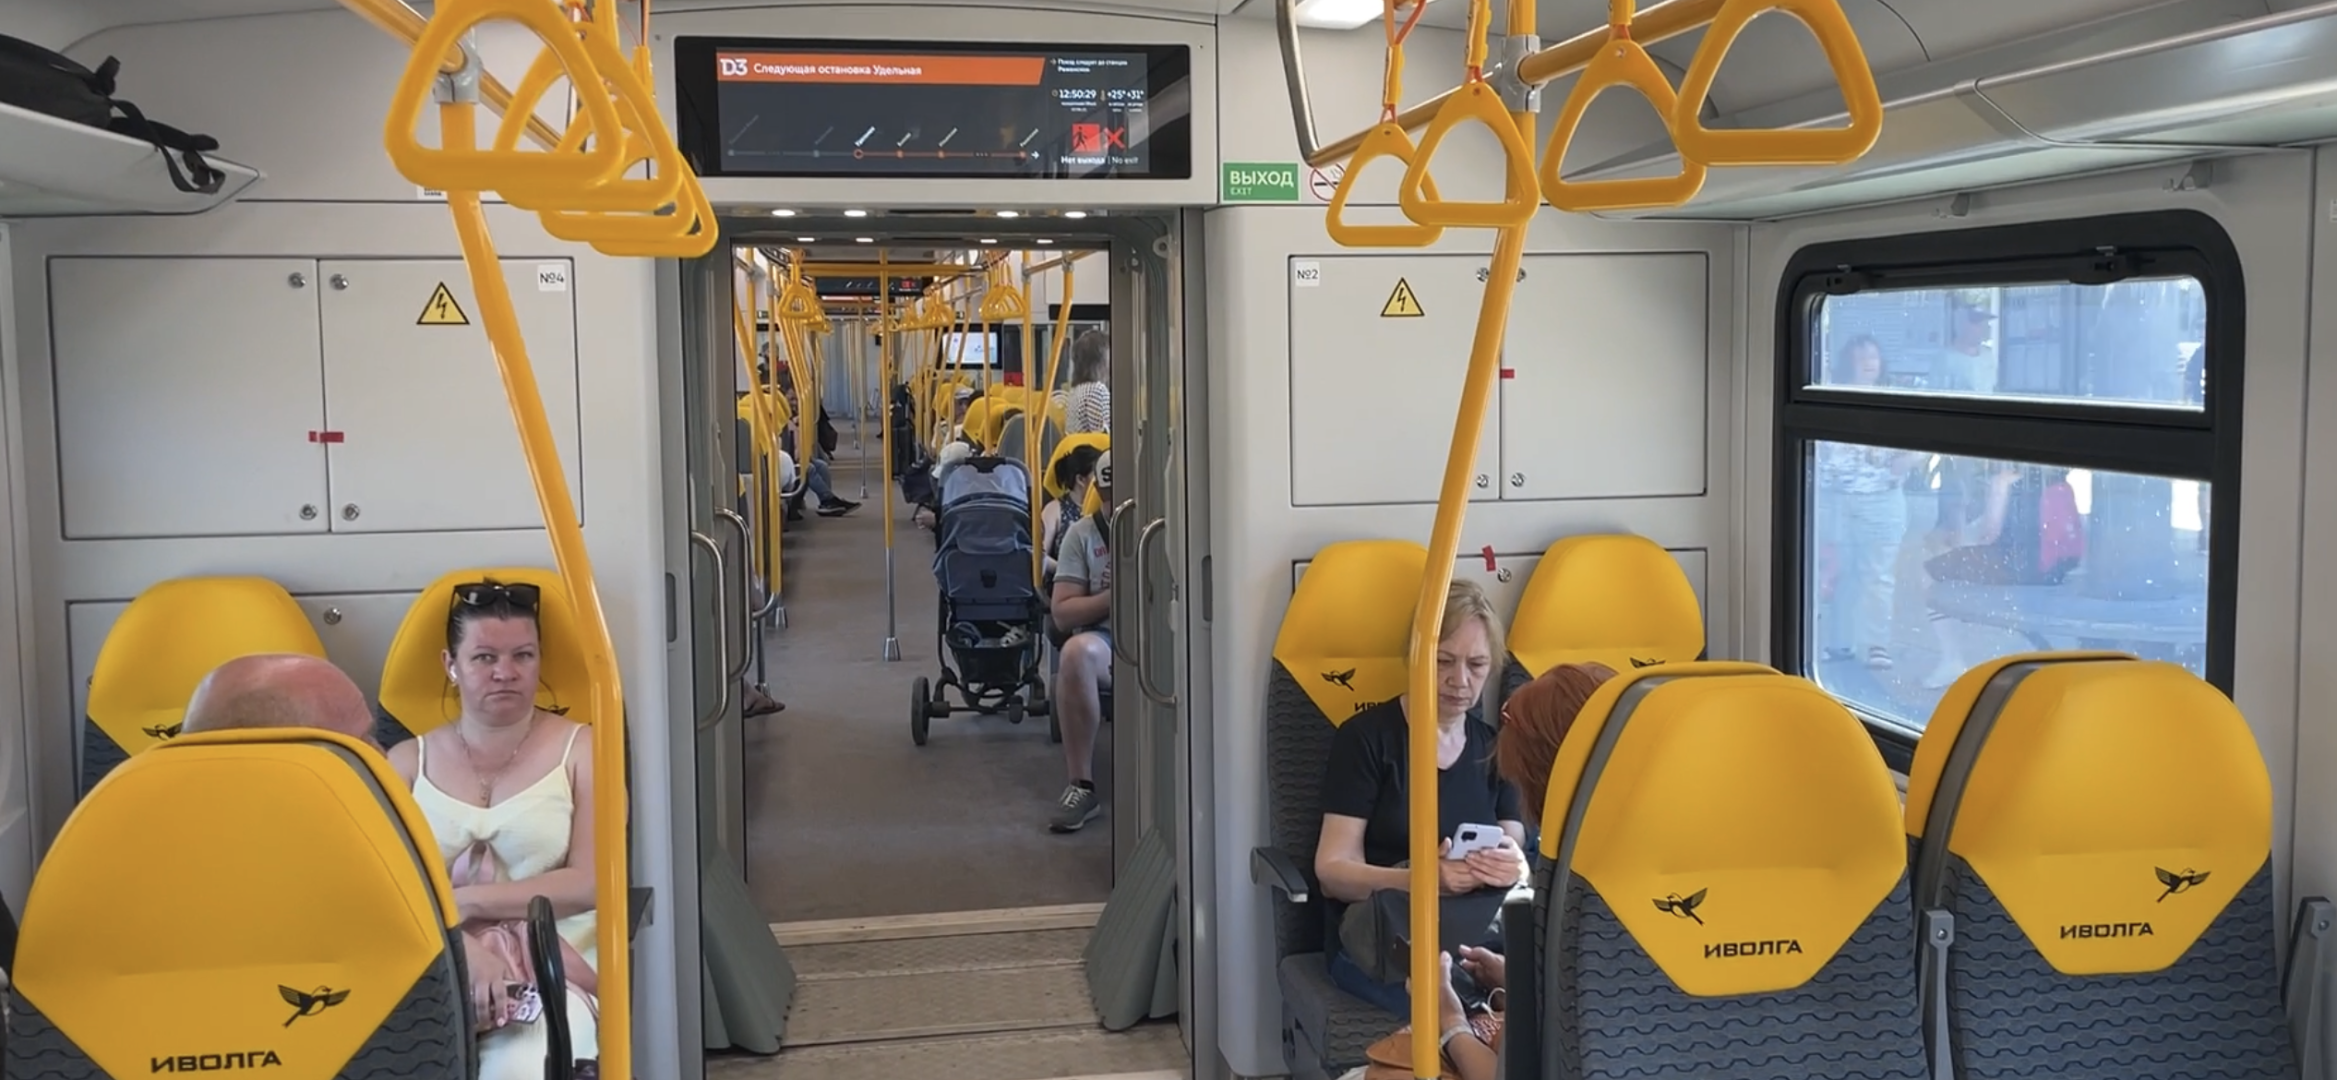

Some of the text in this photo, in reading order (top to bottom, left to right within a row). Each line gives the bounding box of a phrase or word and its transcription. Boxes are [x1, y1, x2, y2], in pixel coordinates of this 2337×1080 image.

[719, 58, 922, 76] D3 Следующая остановка Удельная
[1059, 88, 1097, 99] 12:50:29
[1061, 156, 1076, 164] Нет
[1230, 170, 1294, 188] ВЫХОД
[1230, 187, 1252, 195] EXIT
[540, 272, 564, 284] №4
[1297, 268, 1319, 280] №2
[2060, 922, 2154, 940] ИВОЛГА
[1704, 939, 1803, 959] ИВОЛГА
[150, 1050, 282, 1074] ИВОЛГА
